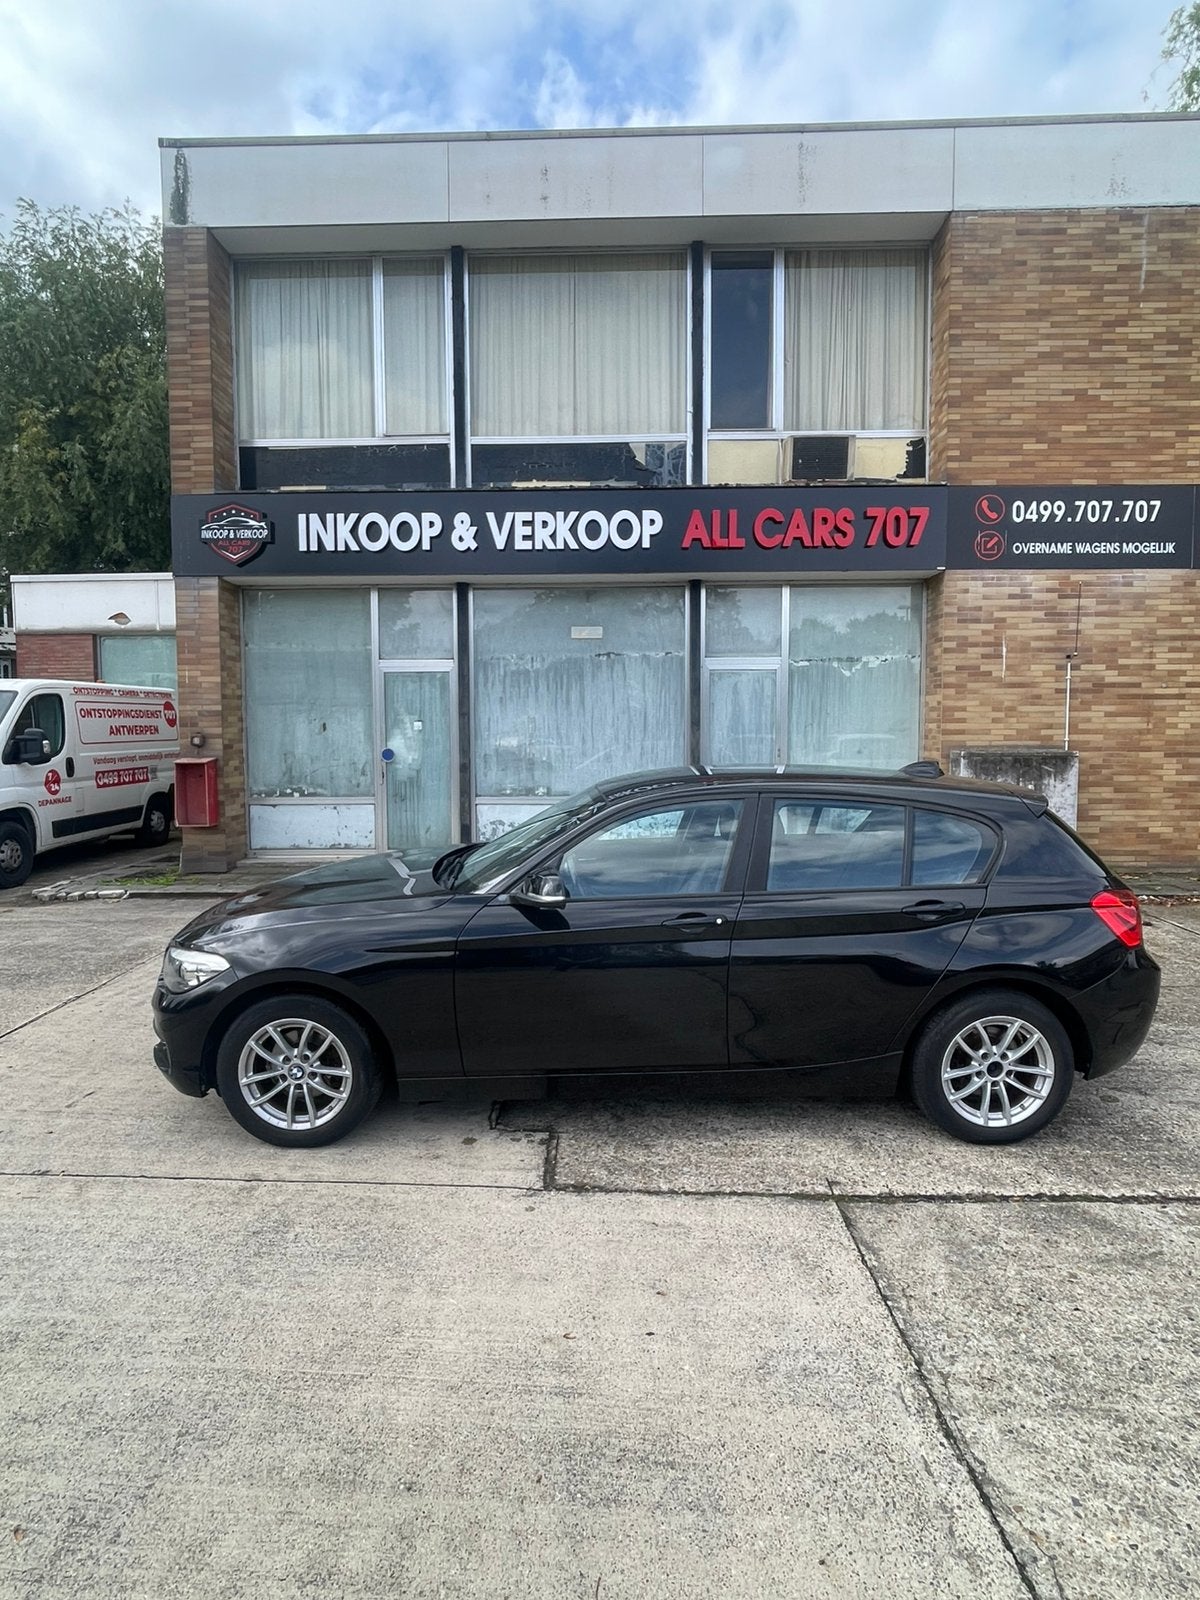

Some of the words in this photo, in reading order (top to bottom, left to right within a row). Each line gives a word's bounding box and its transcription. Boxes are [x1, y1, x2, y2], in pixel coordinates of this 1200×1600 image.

[1012, 500, 1162, 523] 0499.707.707
[201, 529, 229, 539] INKOOP
[236, 529, 268, 539] VERKOOP
[298, 512, 443, 552] INKOOP
[451, 511, 478, 551] &
[486, 509, 664, 551] VERKOOP
[681, 508, 746, 550] ALL
[753, 507, 856, 549] CARS
[863, 506, 930, 548] 707
[1012, 542, 1072, 555] OVERNAME
[1075, 542, 1120, 554] WAGENS
[1122, 542, 1176, 554] MOGELIJK
[80, 708, 162, 719] ONTSTOPPINGSDIENST
[109, 725, 160, 736] ANTWERPEN
